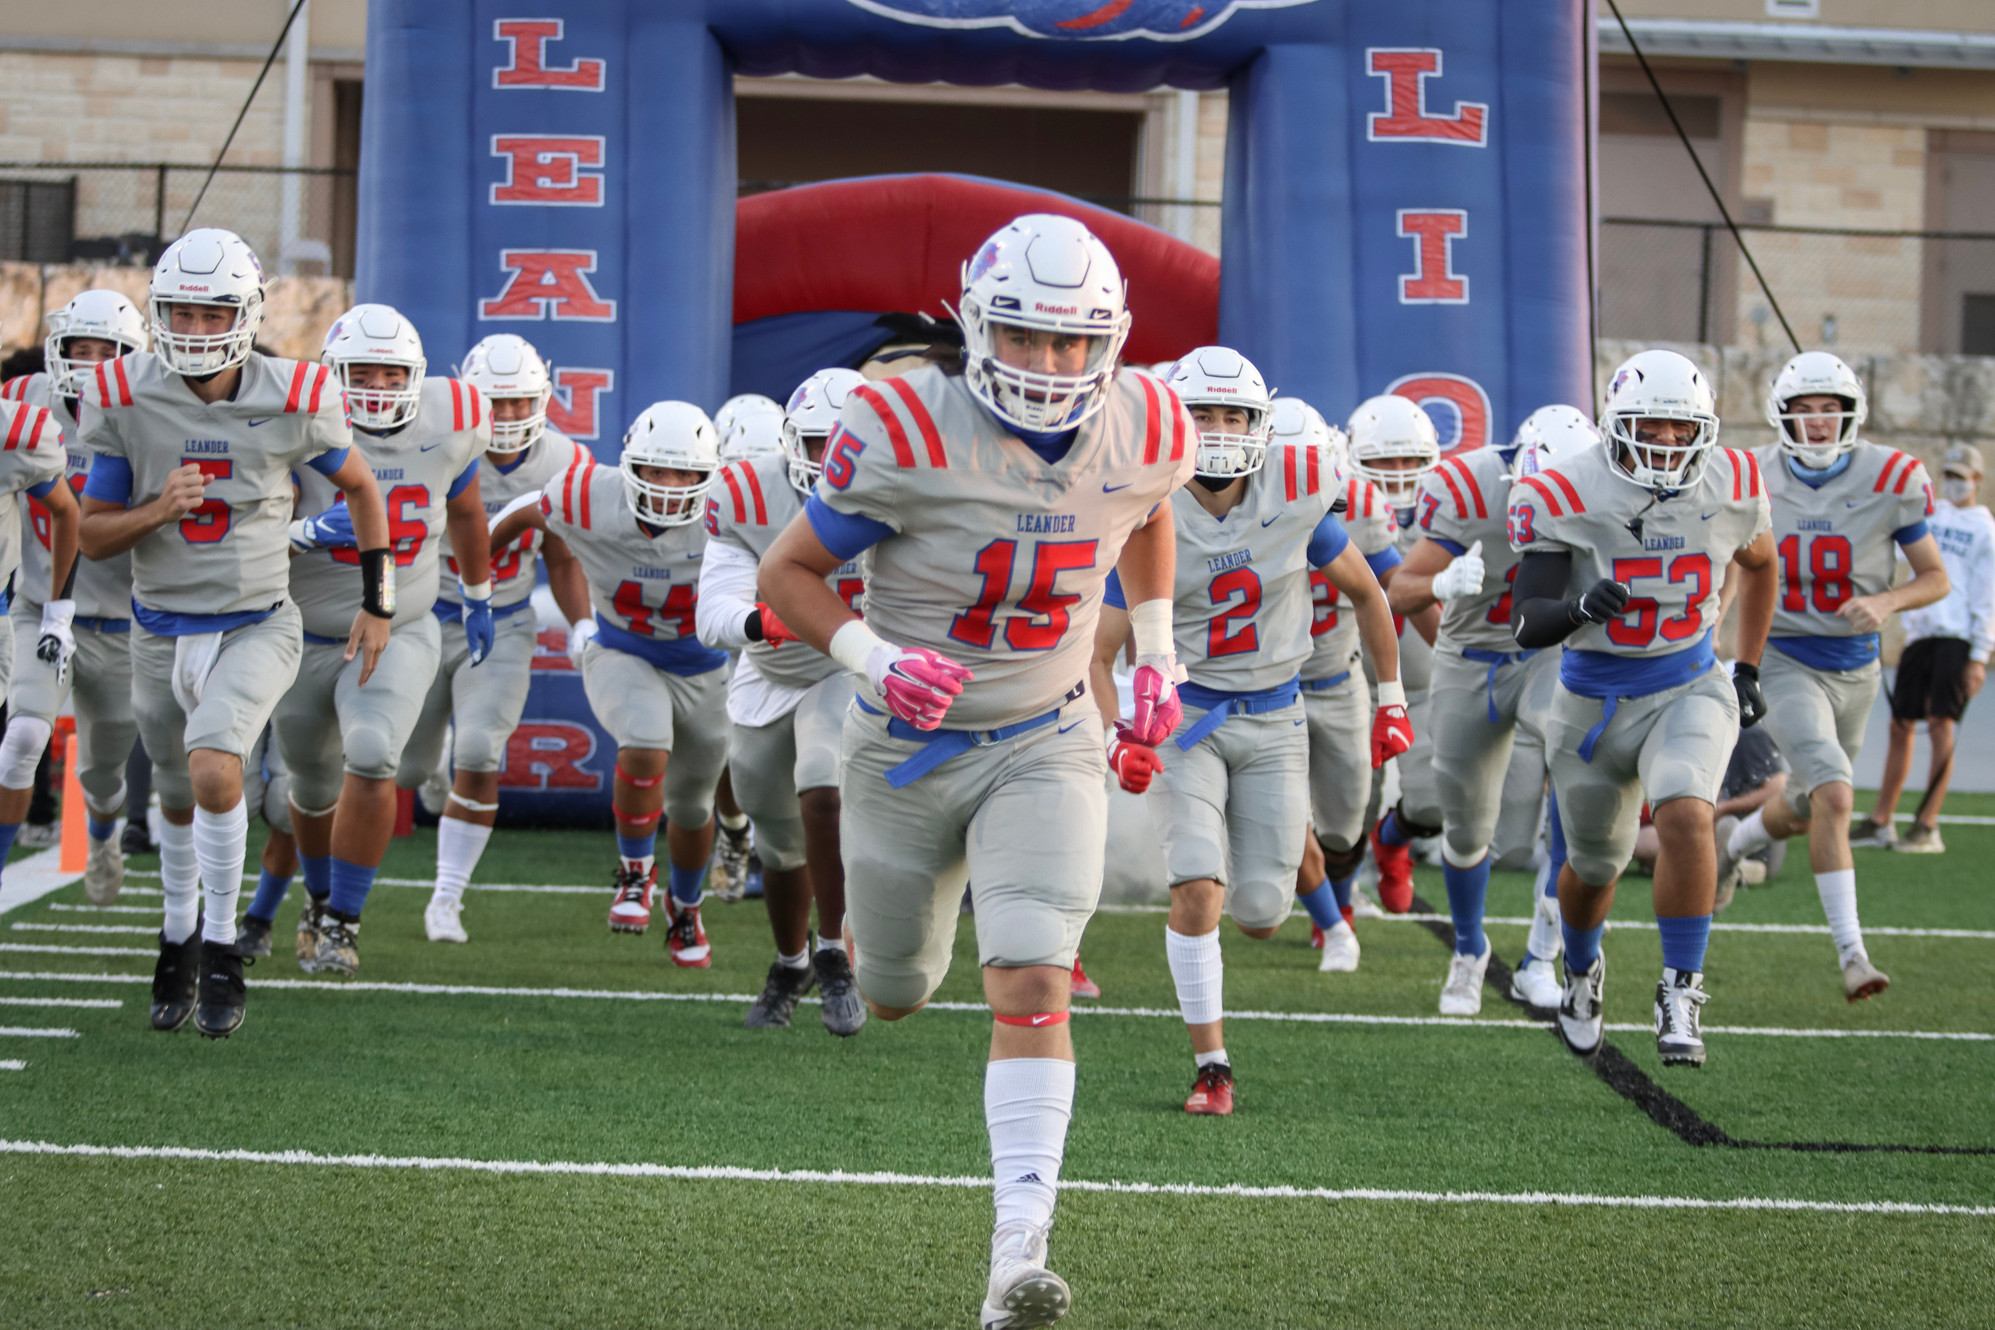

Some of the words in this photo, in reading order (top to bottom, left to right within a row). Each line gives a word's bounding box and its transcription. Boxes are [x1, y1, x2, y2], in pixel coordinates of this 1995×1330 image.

[179, 284, 209, 292] Riddell
[1035, 302, 1078, 315] Riddell
[1207, 386, 1238, 394] Riddell
[185, 440, 229, 453] LEANDER
[1017, 514, 1076, 533] LEANDER
[1797, 519, 1833, 532] LEANDER
[1644, 536, 1686, 551] LEANDER
[1207, 549, 1253, 573] LEANDER
[633, 566, 672, 580] LEANDER
[1778, 535, 1853, 613] 18
[946, 537, 1100, 652] 15
[1605, 551, 1712, 648] 53
[612, 579, 698, 638] 44
[1207, 565, 1263, 659] 2
